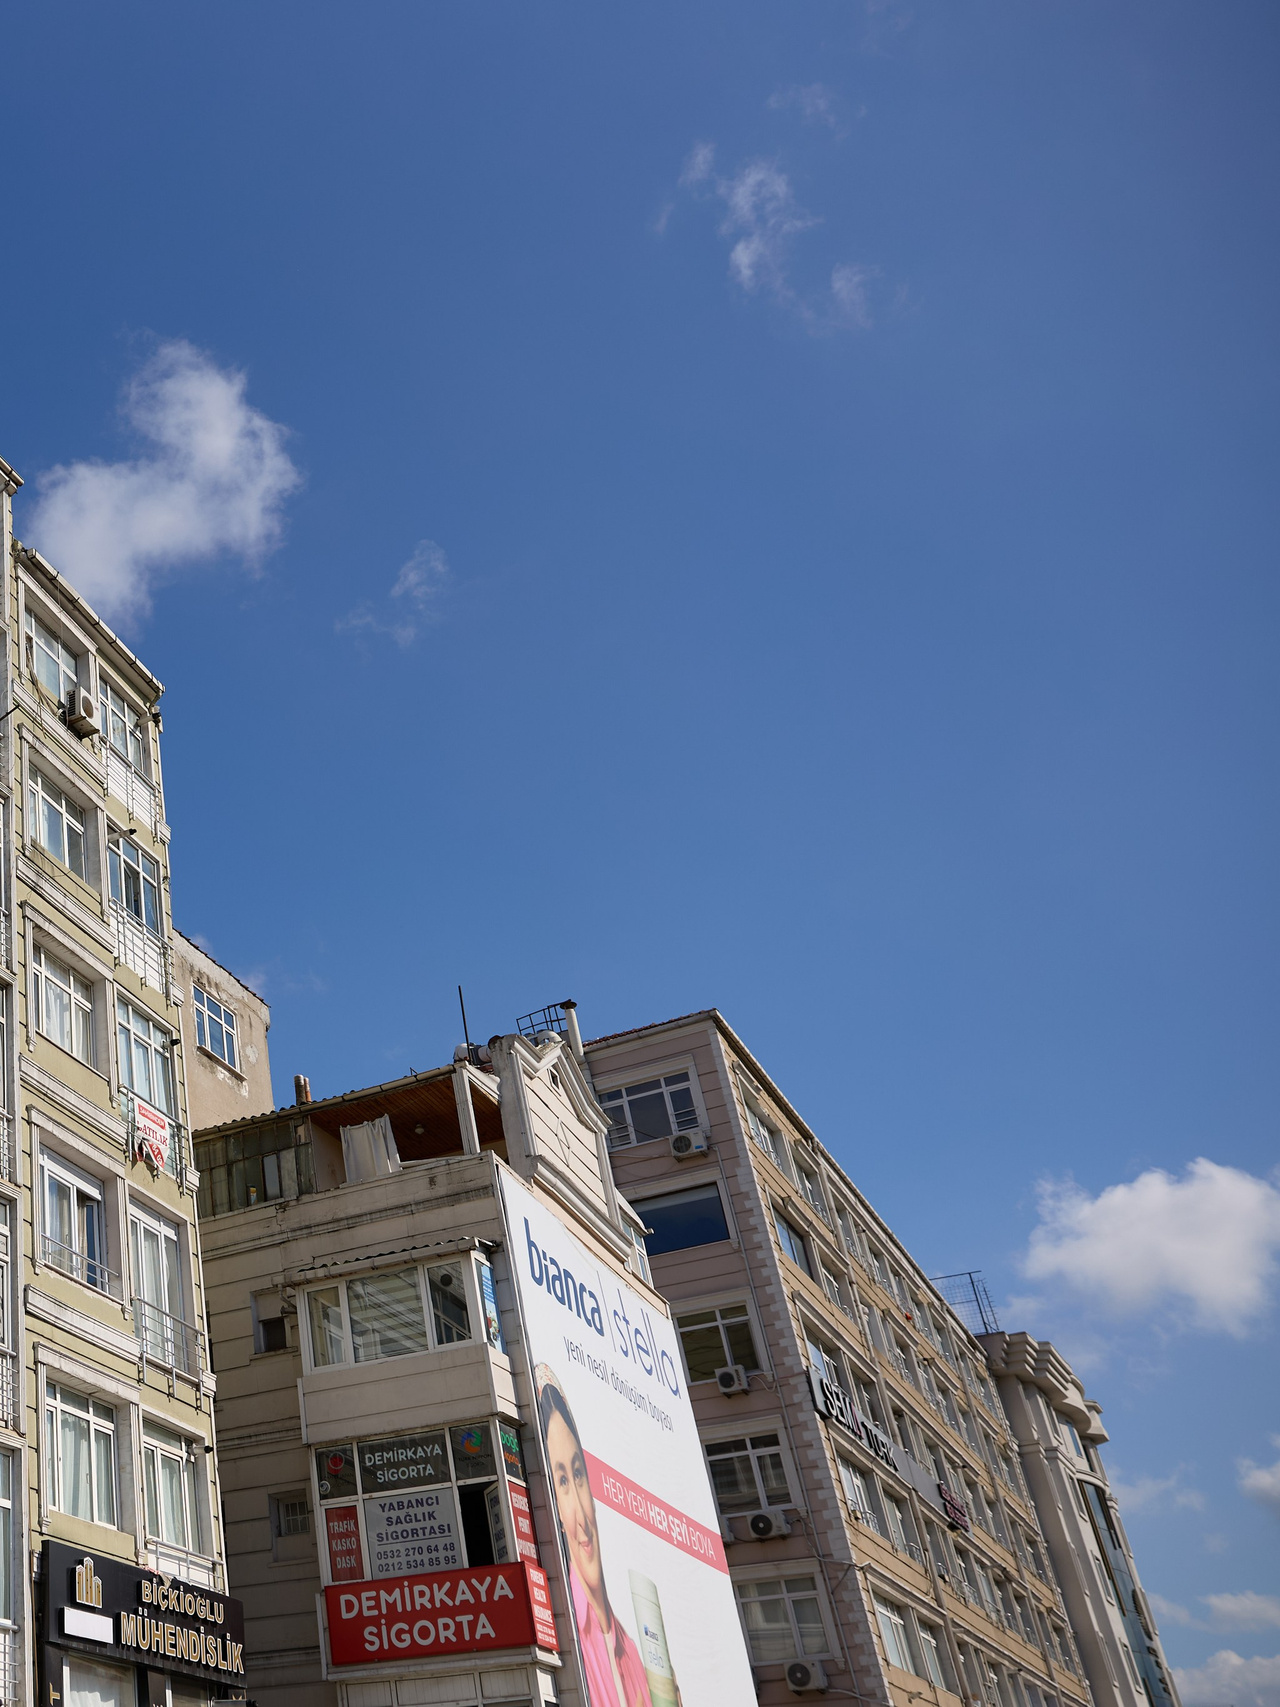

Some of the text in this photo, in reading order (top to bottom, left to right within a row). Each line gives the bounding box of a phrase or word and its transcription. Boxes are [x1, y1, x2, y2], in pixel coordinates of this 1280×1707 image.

[523, 1216, 682, 1400] bianca stella
[563, 1335, 586, 1369] yeni
[587, 1352, 610, 1386] nesil
[364, 1443, 443, 1467] DEMİRKAYA
[376, 1463, 435, 1483] SİGORTA
[379, 1495, 440, 1513] YABANCI
[329, 1516, 357, 1533] TRAFİK
[385, 1510, 437, 1527] SAĞLIK
[601, 1472, 717, 1561] HER YERİ HER ŞEYİ BOYA
[376, 1523, 452, 1543] SİGORTASI
[331, 1536, 357, 1552] KASKO
[376, 1542, 456, 1561] 0532 270 64 48
[336, 1554, 357, 1570] DASK
[378, 1555, 457, 1573] 0212 534 85 95
[141, 1577, 225, 1625] BİÇKİOĞLU
[339, 1574, 514, 1620] DEMİRKAYA
[120, 1607, 245, 1675] MÜHENDİSLİK
[363, 1613, 496, 1652] SİGORTA
